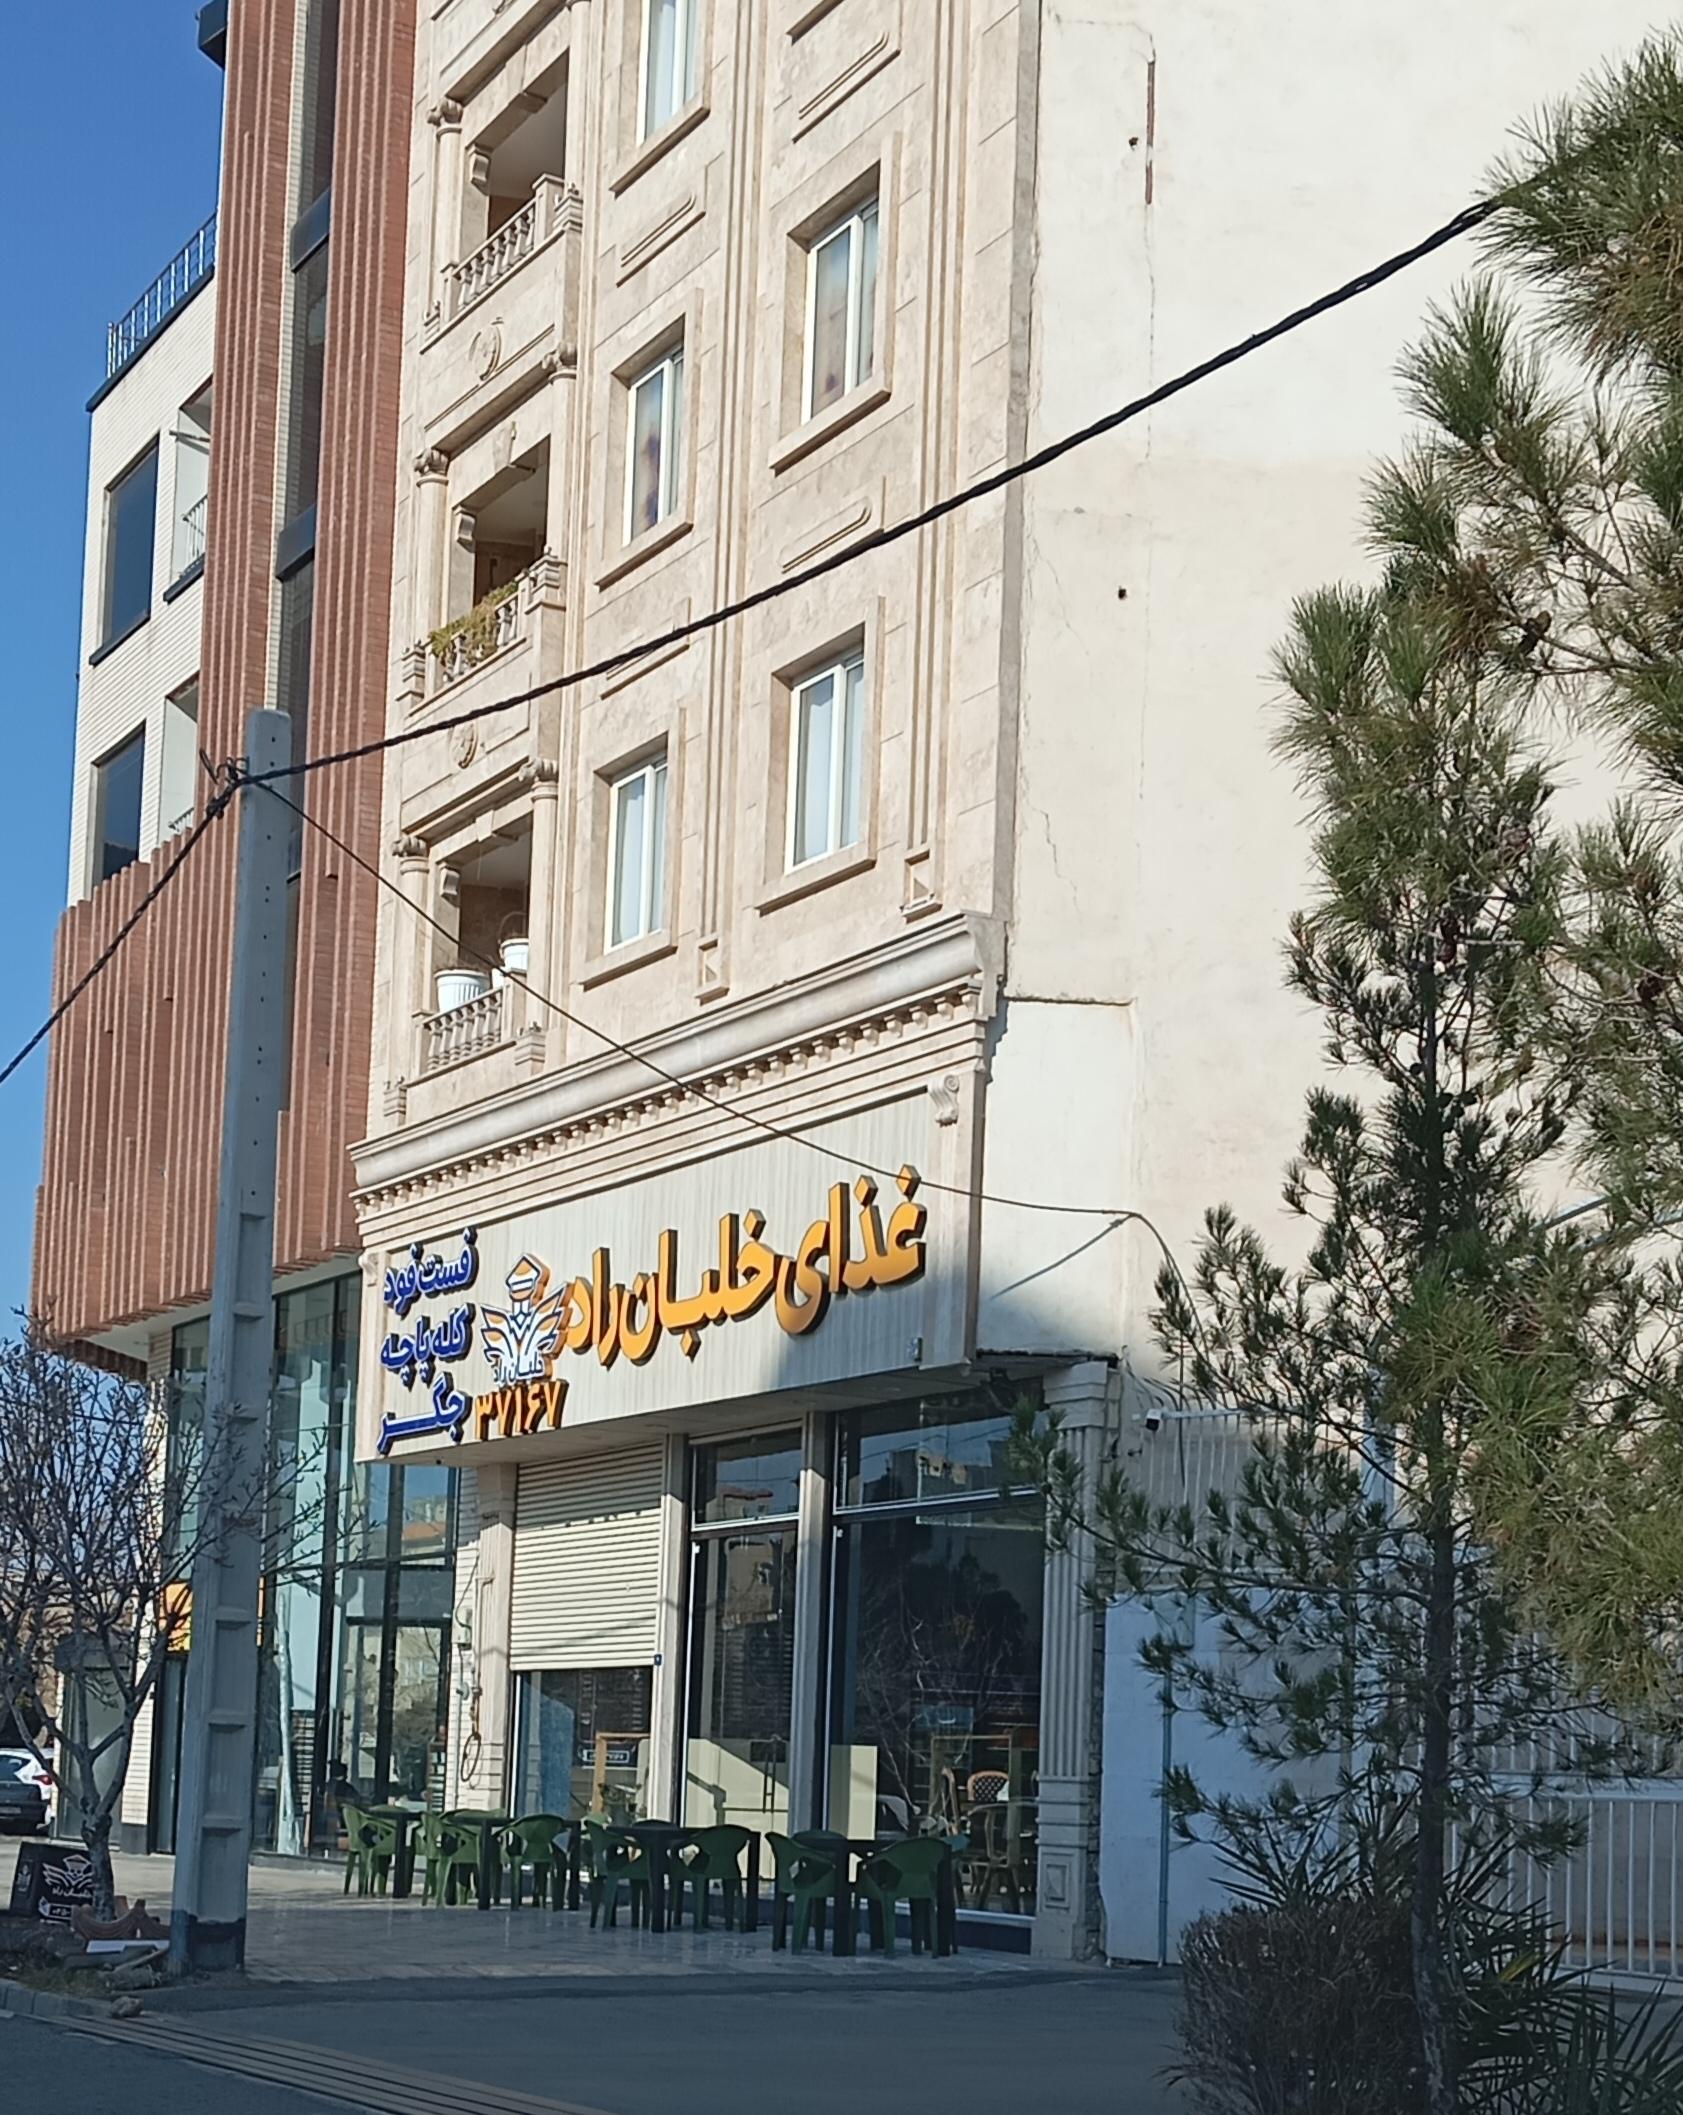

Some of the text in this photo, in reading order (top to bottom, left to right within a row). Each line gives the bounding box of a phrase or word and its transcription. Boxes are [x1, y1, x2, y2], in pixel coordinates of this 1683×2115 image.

[384, 1228, 478, 1317] فست فود
[566, 1164, 927, 1371] غذای خلبان راد
[380, 1303, 475, 1390] کله پاچه
[377, 1371, 472, 1455] جگر
[475, 1379, 569, 1441] ۳۷۱۶۷
